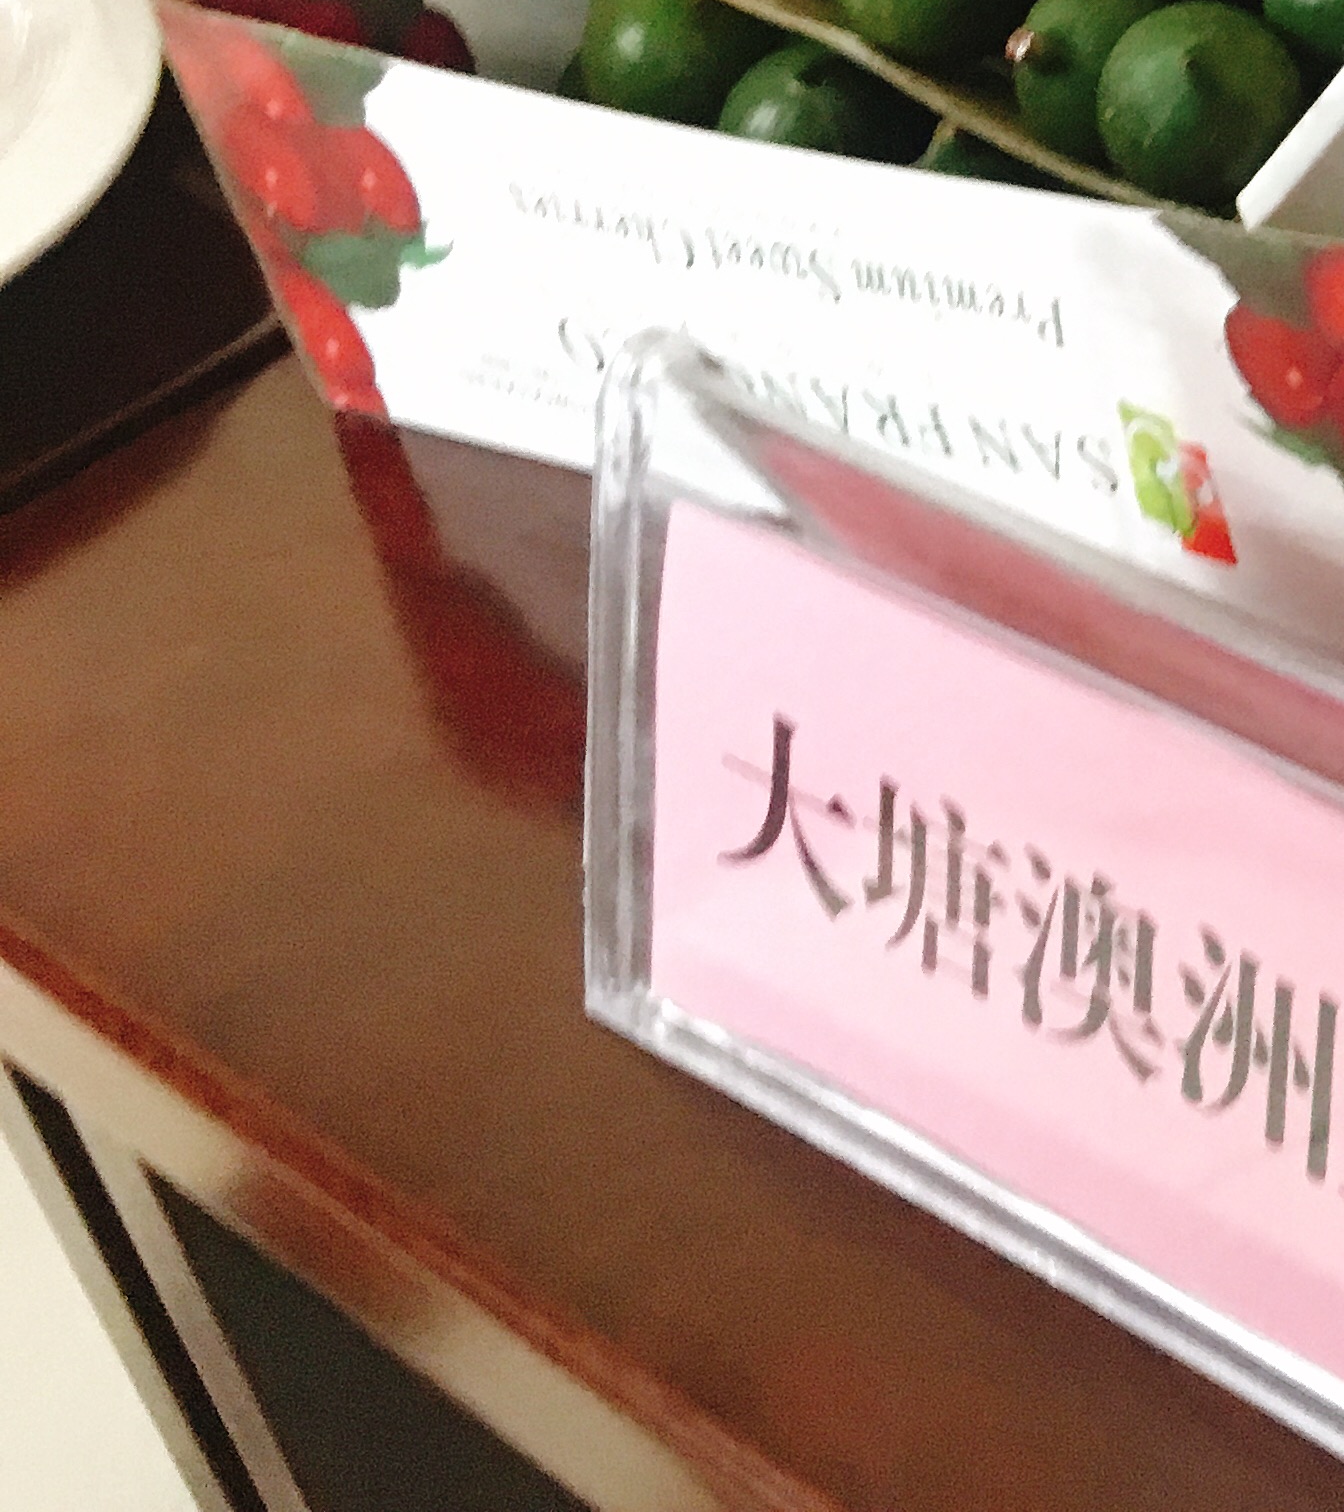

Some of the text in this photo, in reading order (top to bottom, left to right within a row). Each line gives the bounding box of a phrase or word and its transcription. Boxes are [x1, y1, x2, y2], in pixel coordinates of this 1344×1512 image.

[707, 226, 842, 304] Sweet
[851, 258, 1064, 348] Premium
[968, 416, 1118, 493] SAN
